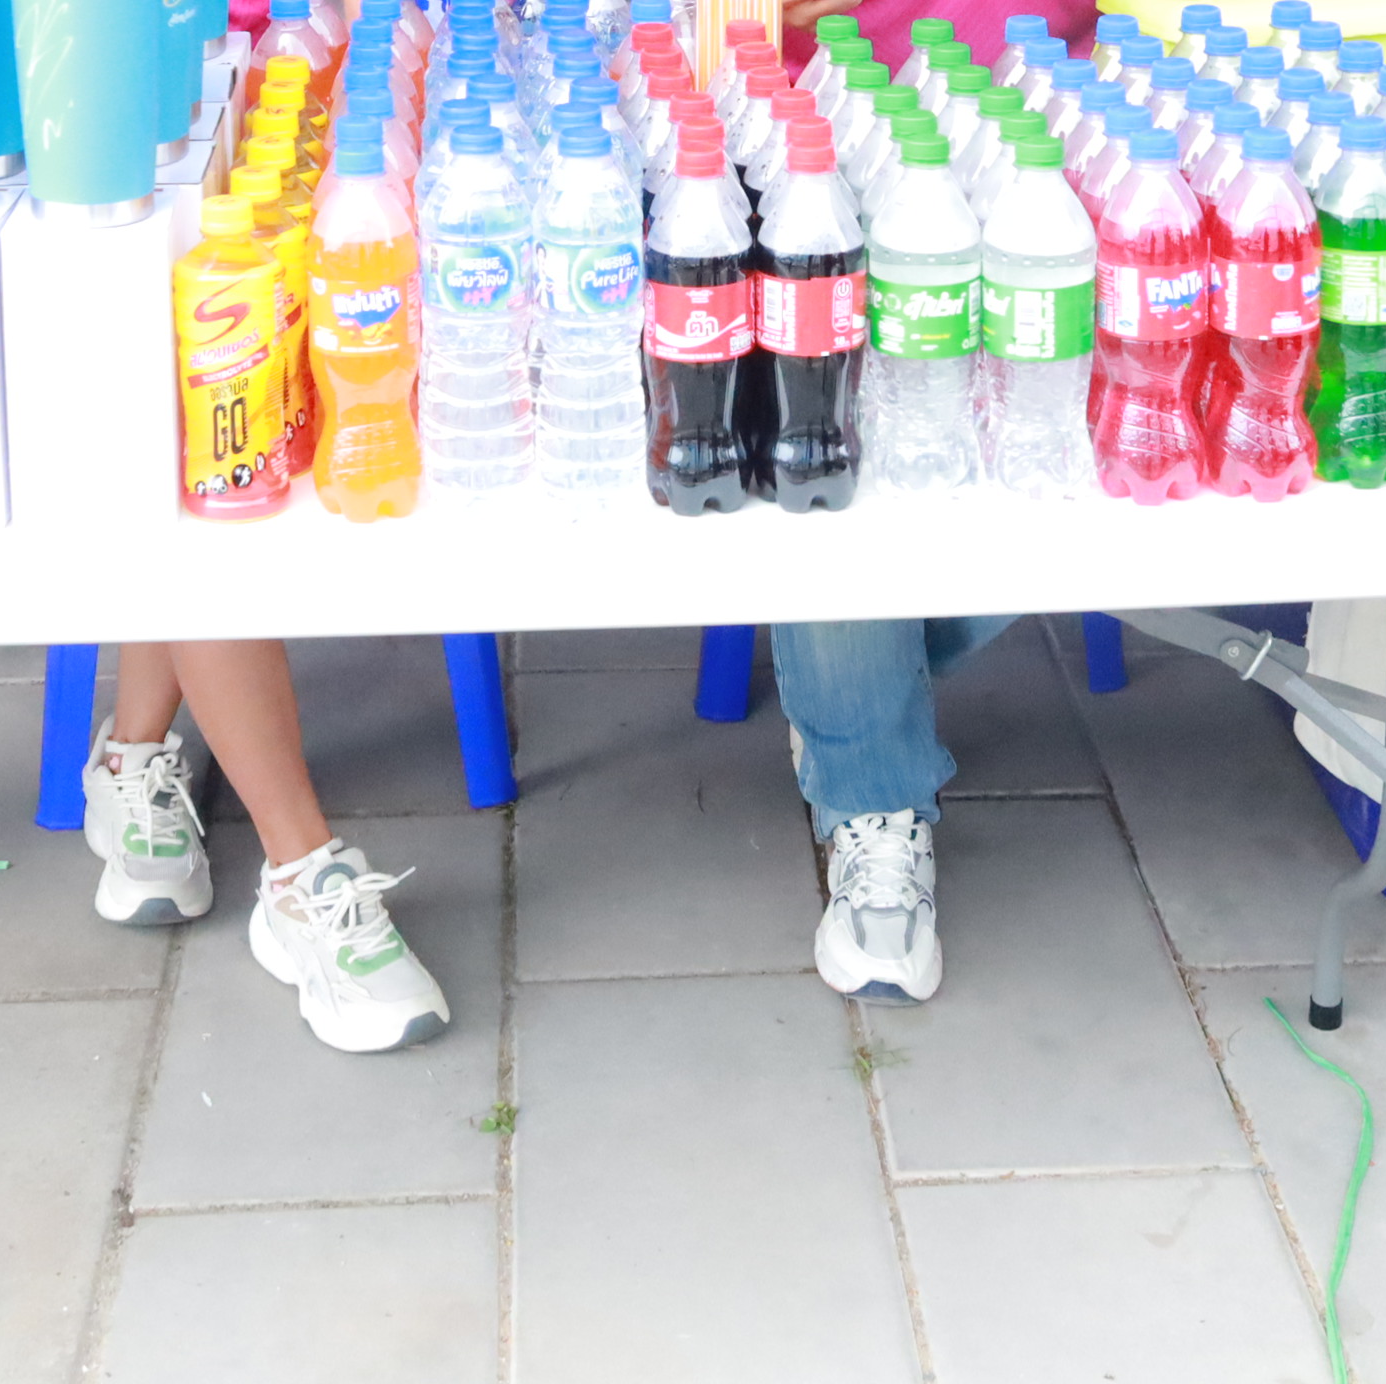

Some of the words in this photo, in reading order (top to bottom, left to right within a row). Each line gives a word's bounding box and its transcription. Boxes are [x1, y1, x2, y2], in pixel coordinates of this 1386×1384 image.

[580, 270, 617, 290] Pure
[1145, 270, 1204, 303] FANTA
[213, 397, 249, 462] GO
